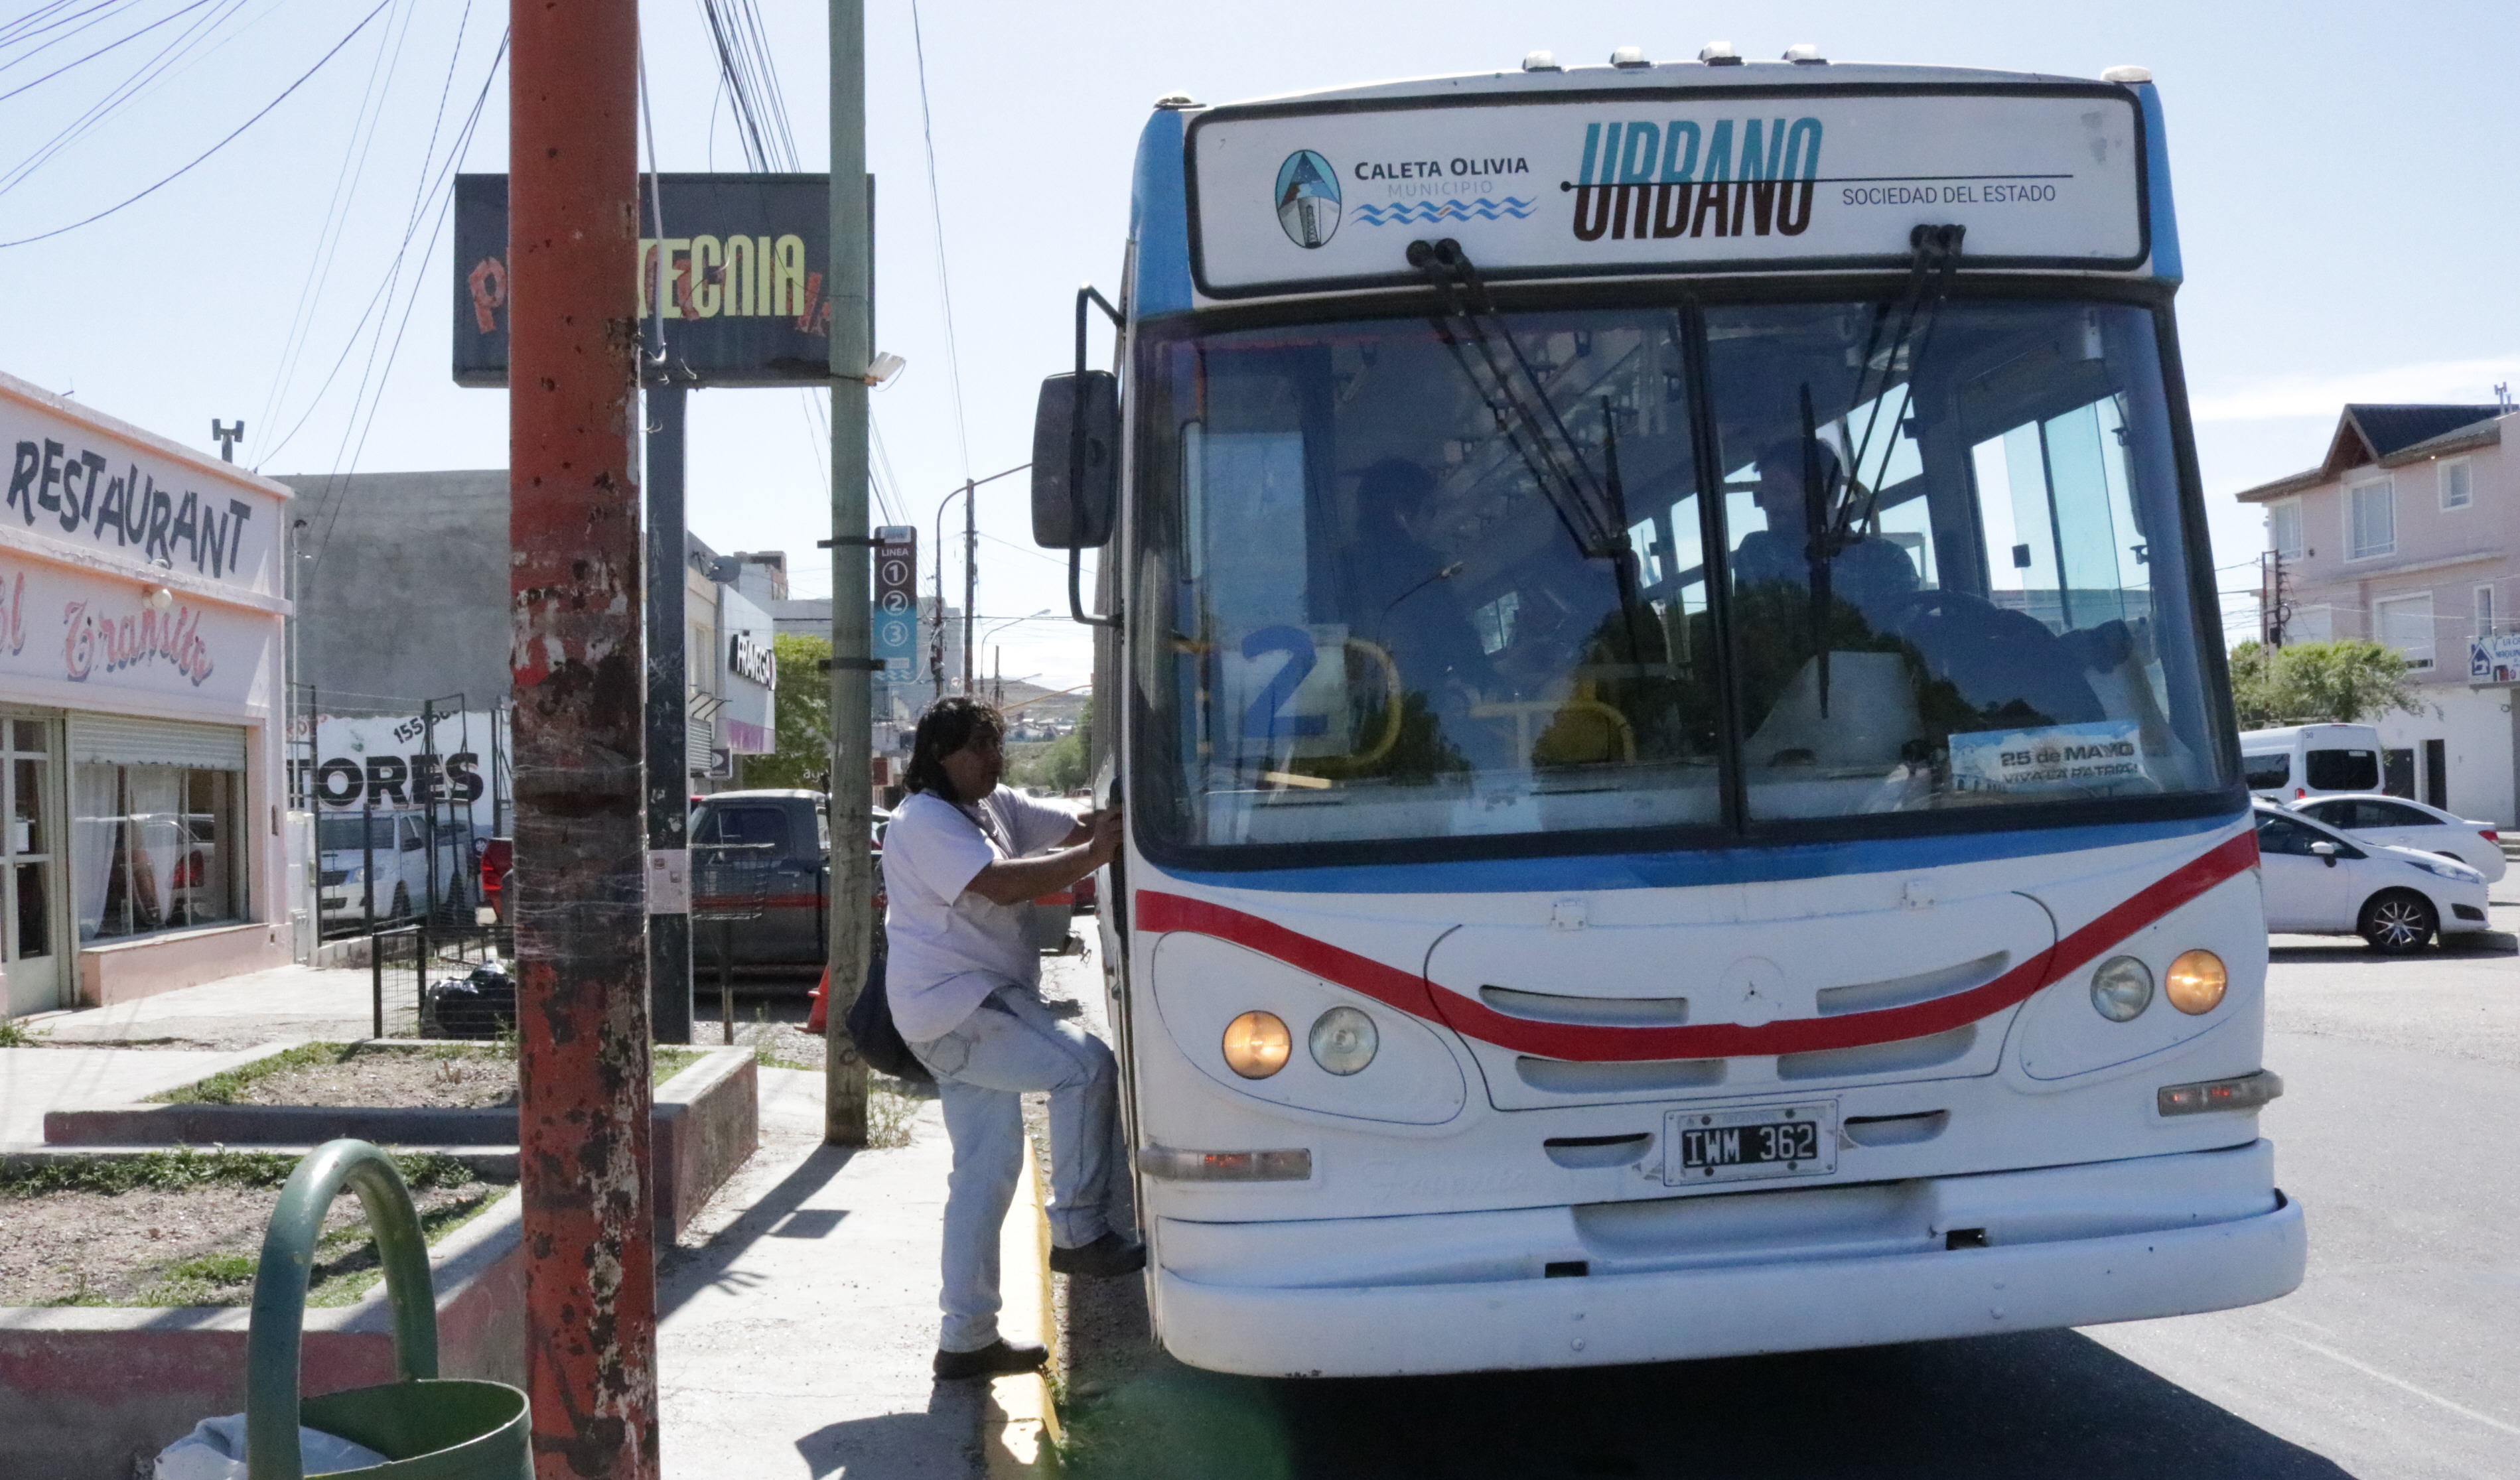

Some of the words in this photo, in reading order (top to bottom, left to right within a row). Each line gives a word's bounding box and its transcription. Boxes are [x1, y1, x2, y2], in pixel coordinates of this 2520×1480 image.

[1354, 161, 1443, 180] CALETA
[1450, 157, 1529, 176] OLIVIA
[1573, 117, 1824, 242] URBANO
[1387, 180, 1493, 198] MUNICIPIO
[1842, 187, 1938, 206] SOCIEDAD
[1943, 186, 1979, 203] DEL
[1983, 184, 2056, 203] ESTADO
[6, 437, 252, 579] RESTAURANT
[881, 548, 909, 557] LINEA
[890, 565, 898, 581] 1
[890, 594, 902, 611] 2
[890, 625, 902, 643] 3
[1240, 624, 1328, 738] 2
[2000, 750, 2031, 767] 25
[2035, 750, 2061, 764] de
[2064, 741, 2135, 762] MAYO
[1685, 1128, 1740, 1166] IWM
[1759, 1124, 1814, 1160] 362
